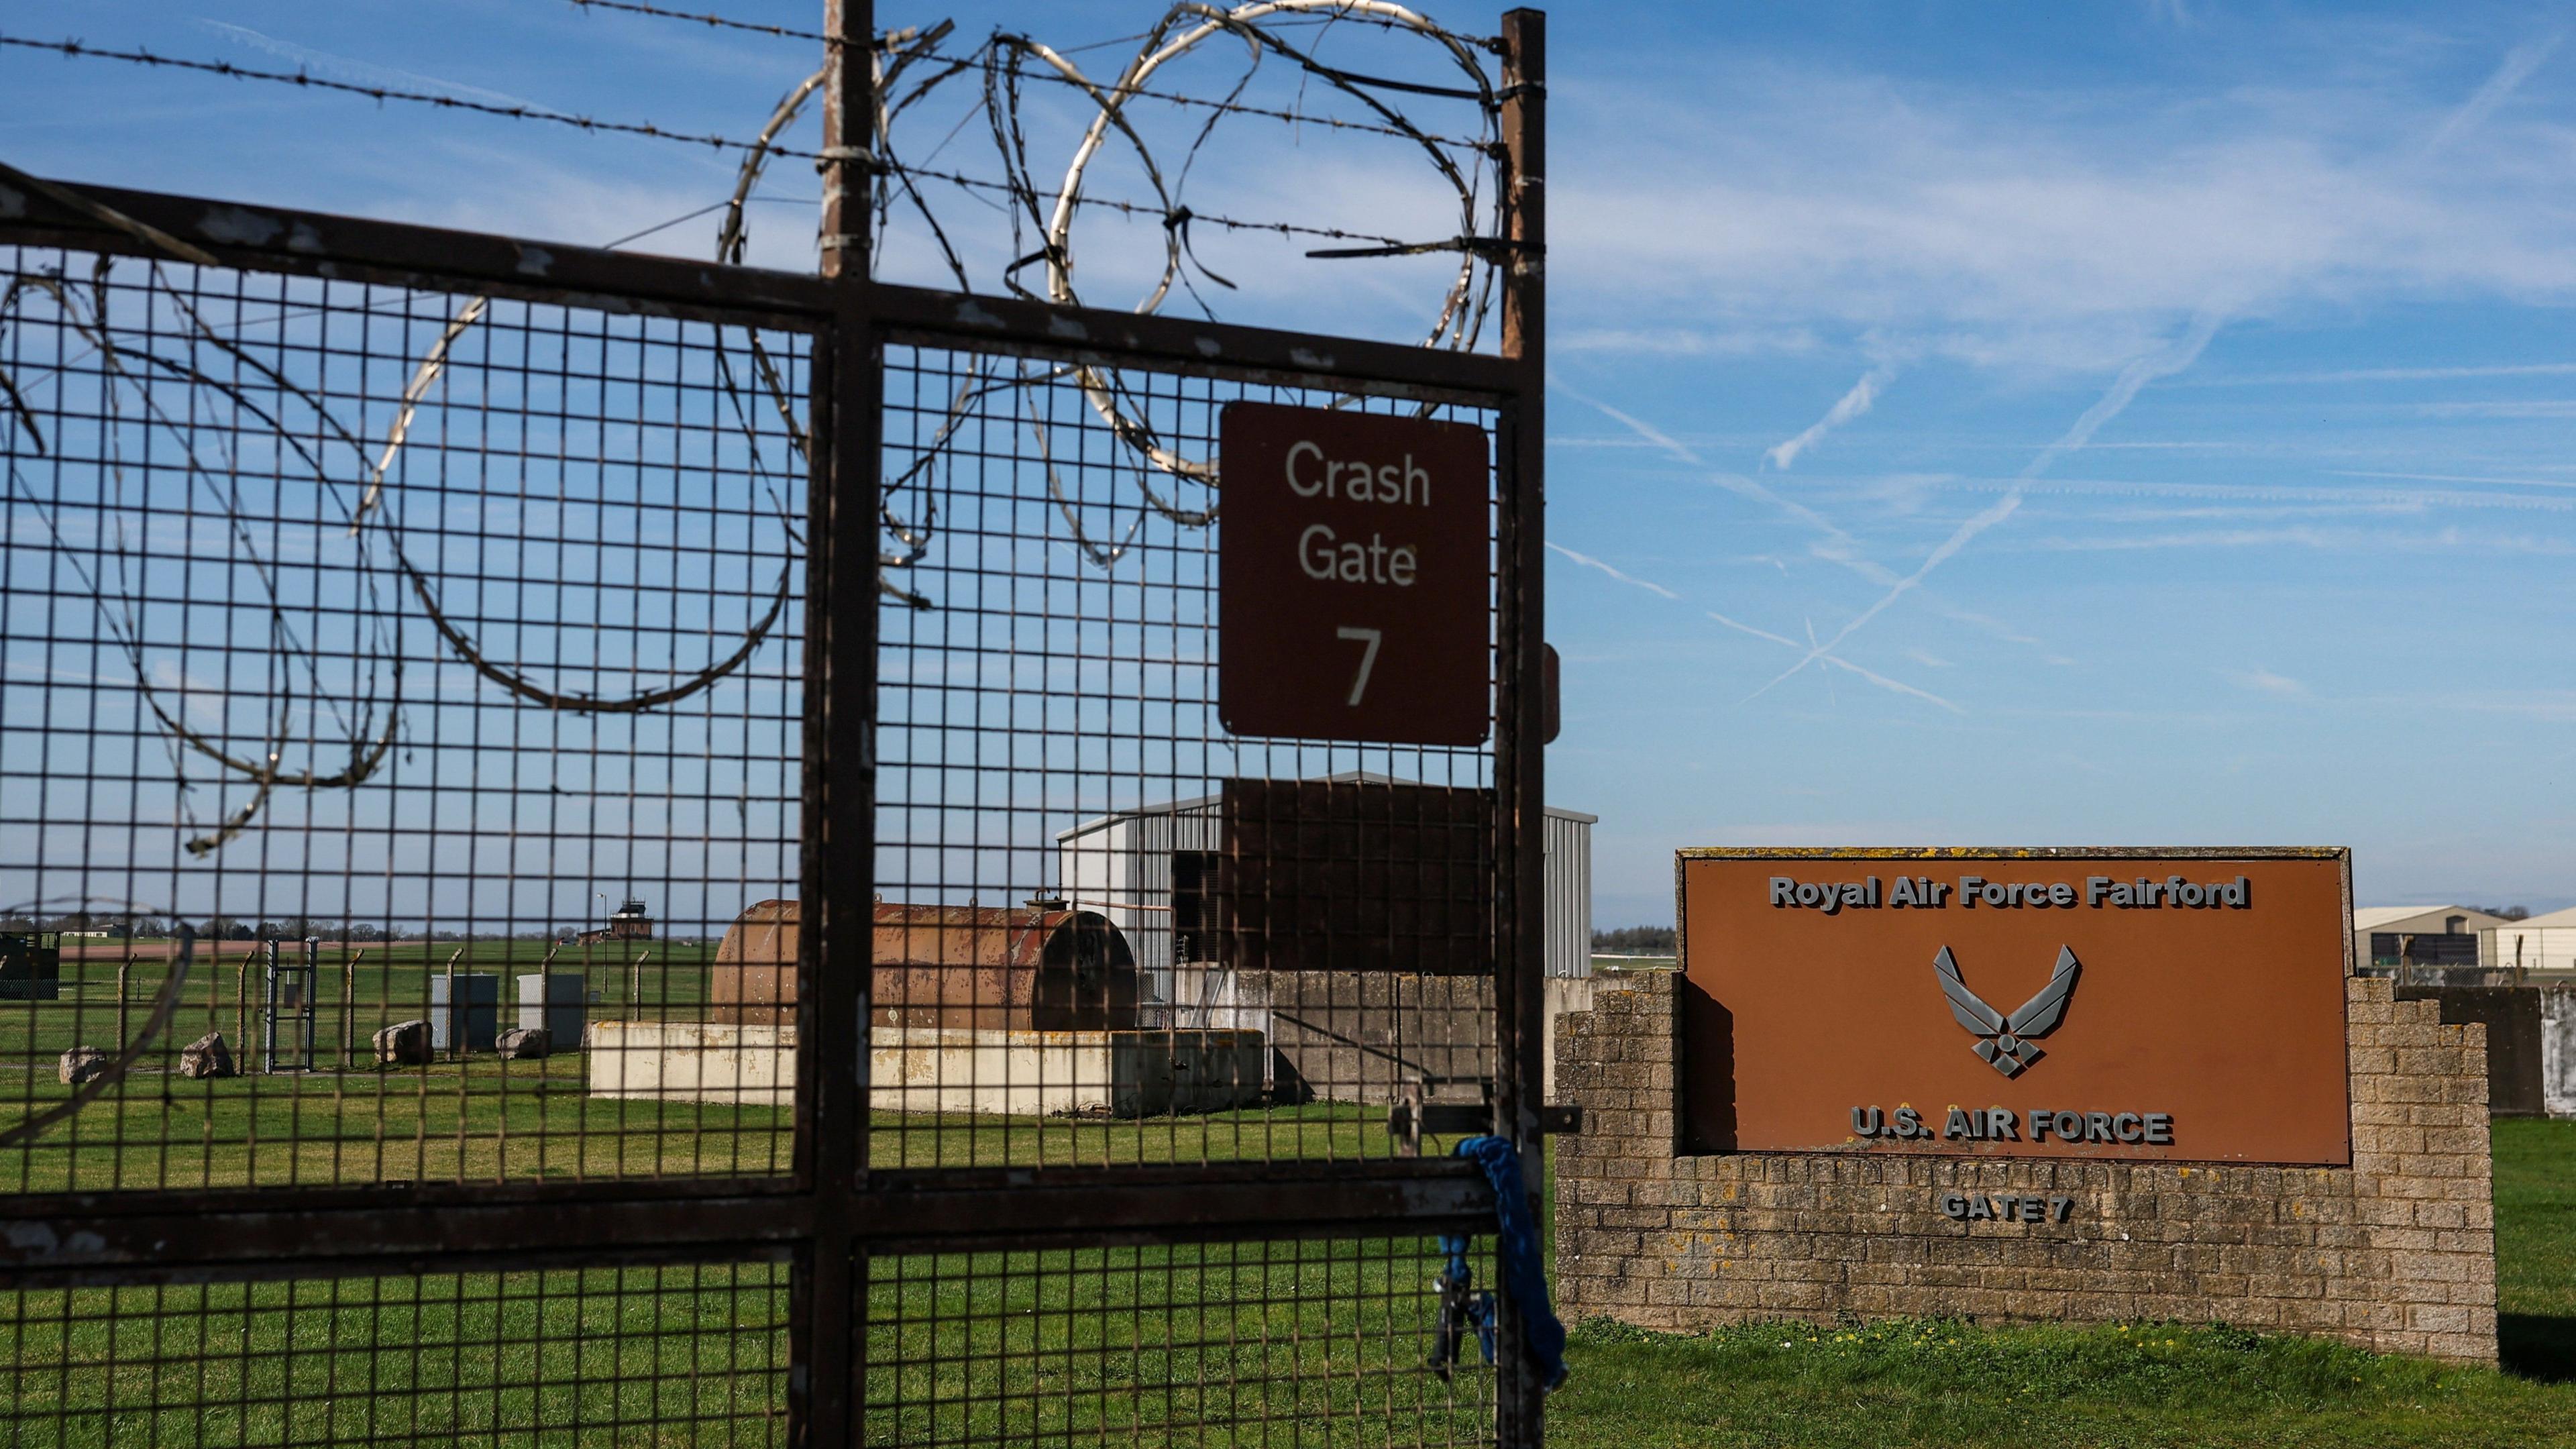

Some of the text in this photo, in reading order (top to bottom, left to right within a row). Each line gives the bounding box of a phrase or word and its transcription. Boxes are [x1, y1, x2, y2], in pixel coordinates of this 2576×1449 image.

[1285, 440, 1430, 506] Crash
[1298, 523, 1417, 586] Gate
[1336, 626, 1382, 706] 7
[1769, 875, 2245, 912] Royal Air Force Fairford
[1850, 1106, 2169, 1142] U.S. AIR FORCE
[1940, 1193, 2069, 1221] GATE 7
